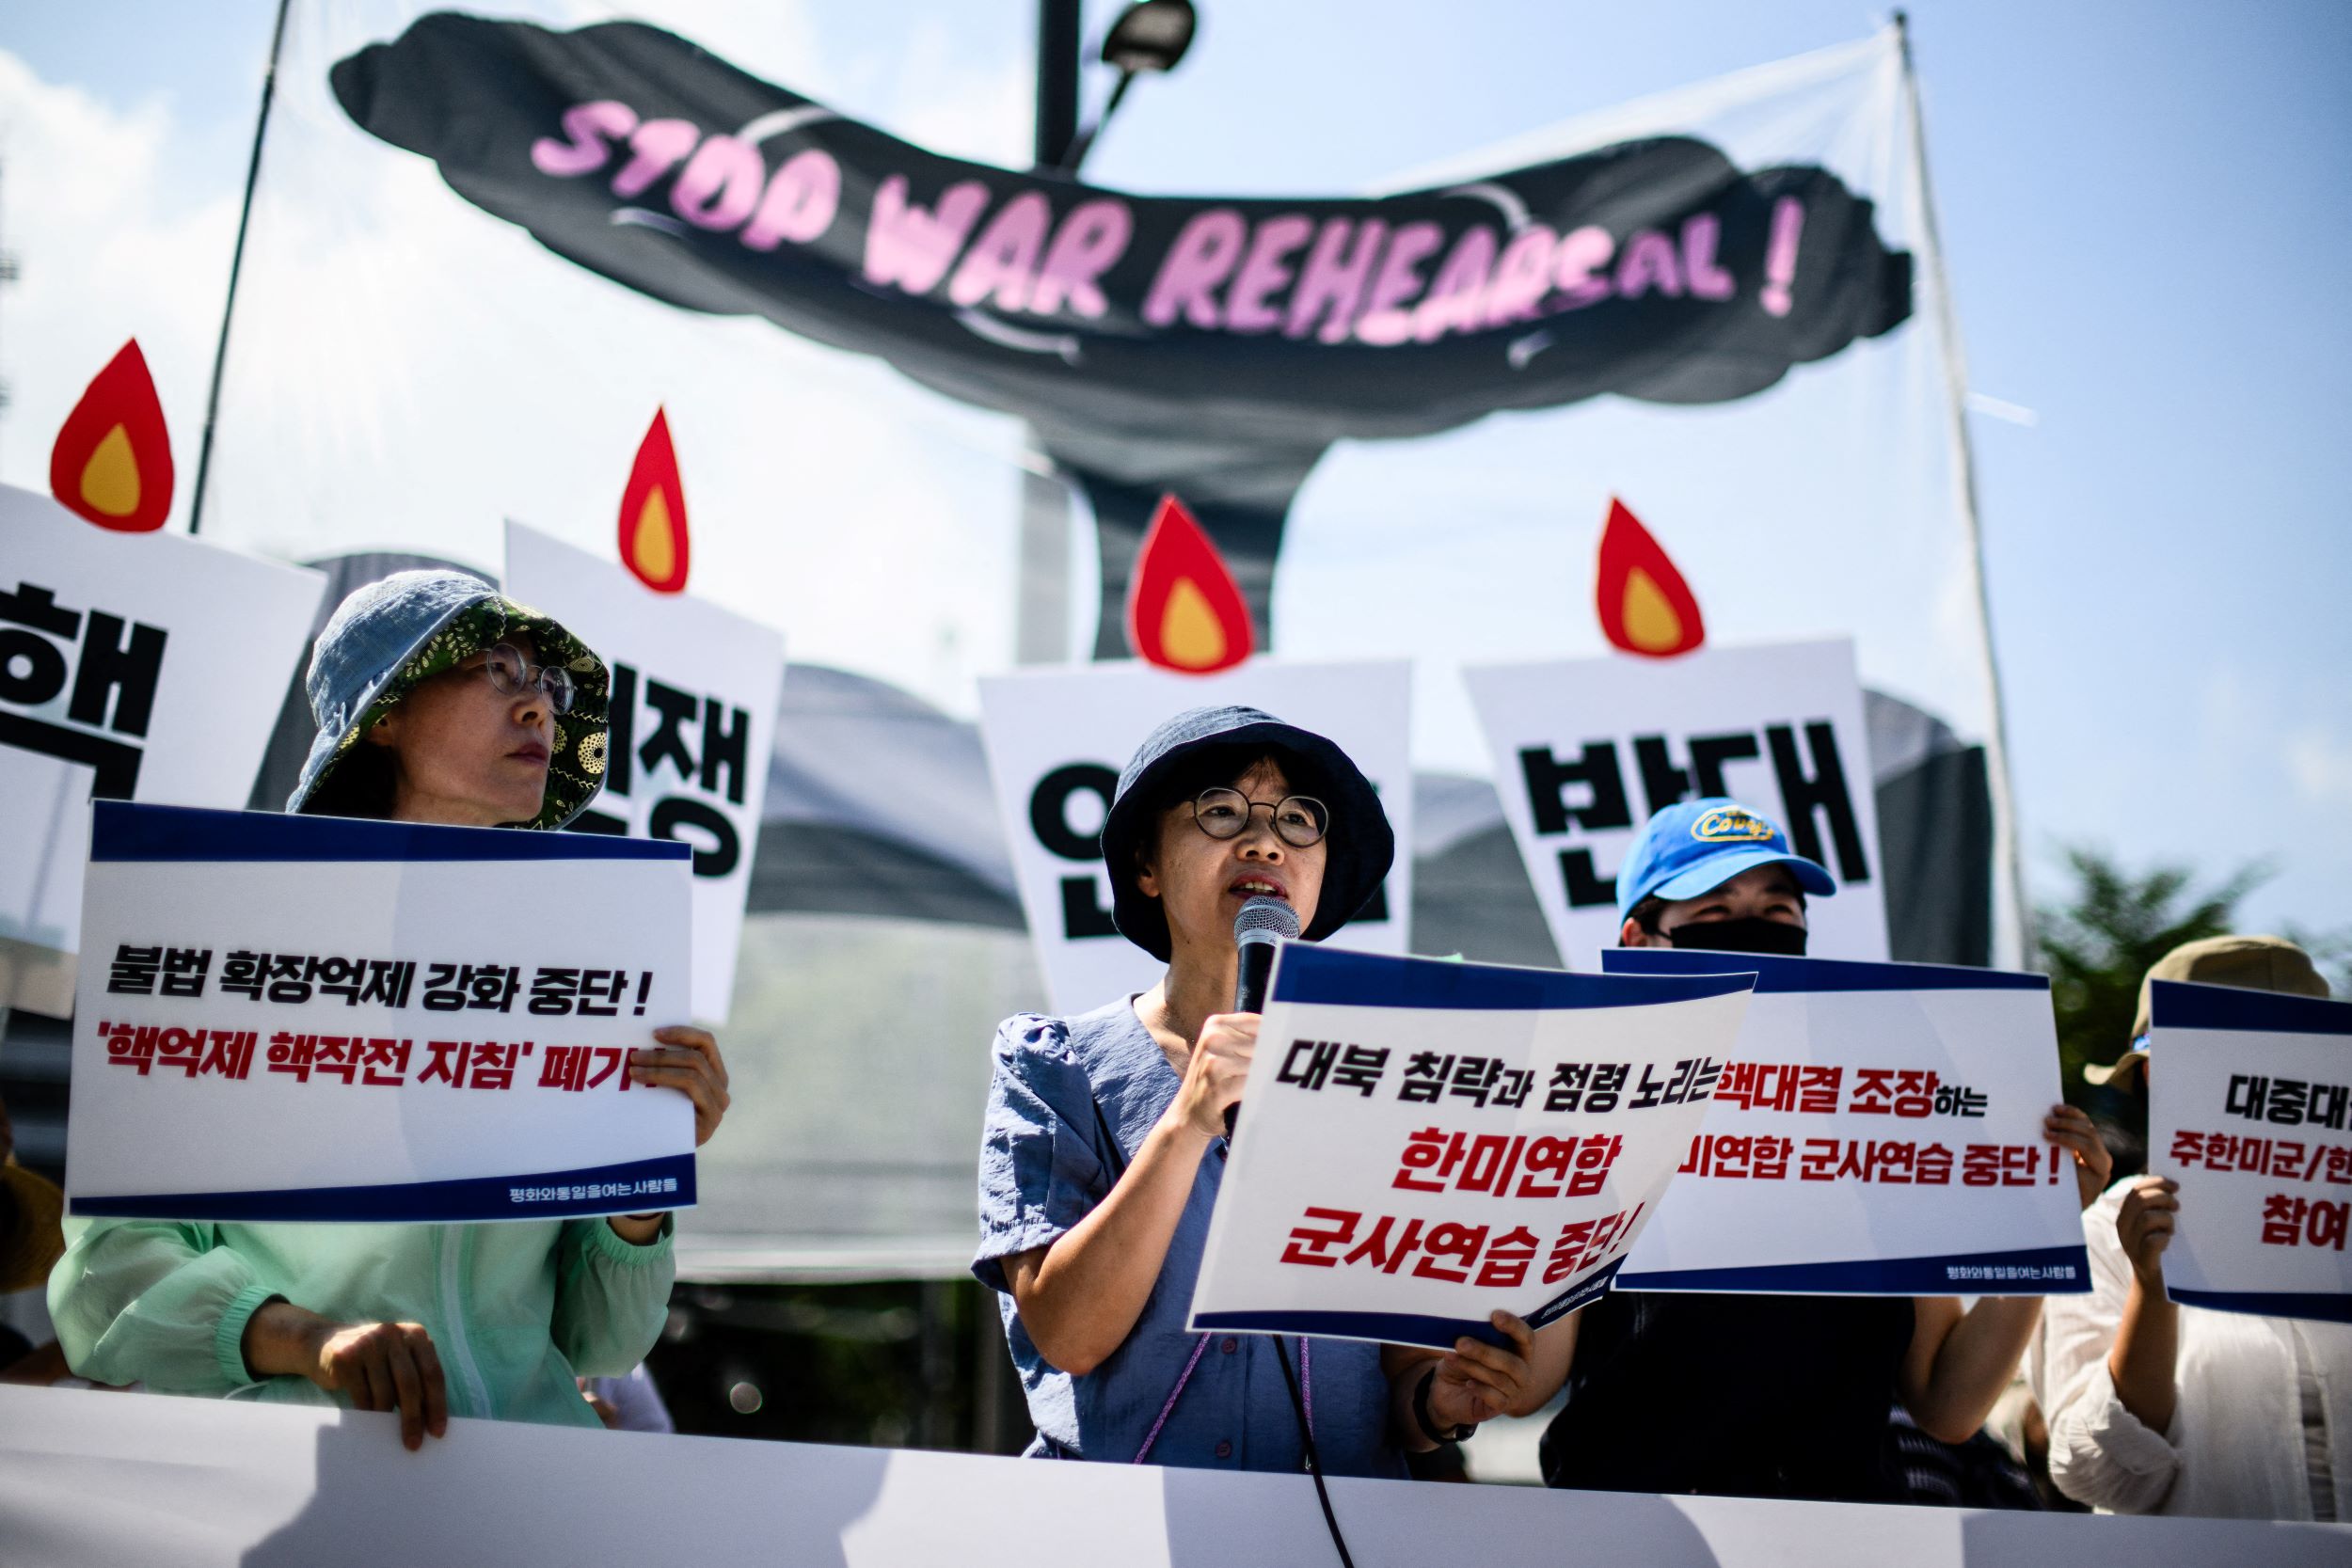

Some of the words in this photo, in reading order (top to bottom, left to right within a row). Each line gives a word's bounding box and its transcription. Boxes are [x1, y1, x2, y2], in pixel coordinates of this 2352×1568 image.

[531, 100, 840, 250] STOP
[864, 174, 1132, 316] WAR
[106, 944, 213, 997] 불법
[218, 950, 417, 1009] 확장억제
[422, 962, 521, 1013] 강화
[266, 1032, 411, 1086] 핵작전
[537, 1045, 666, 1092] 폐기
[1276, 1038, 1391, 1098] 대북
[1397, 1051, 1534, 1109] 침략과
[1542, 1062, 1631, 1114] 점령
[1848, 1069, 1988, 1118] 조장하는
[2226, 1074, 2352, 1131] 대중대
[509, 1178, 678, 1203] 평화와통일을여는사람들
[1391, 1127, 1623, 1198] 한미연합
[1800, 1138, 1953, 1186] 군사연습
[1279, 1207, 1540, 1288] 군사연습
[2262, 1193, 2350, 1252] 참여
